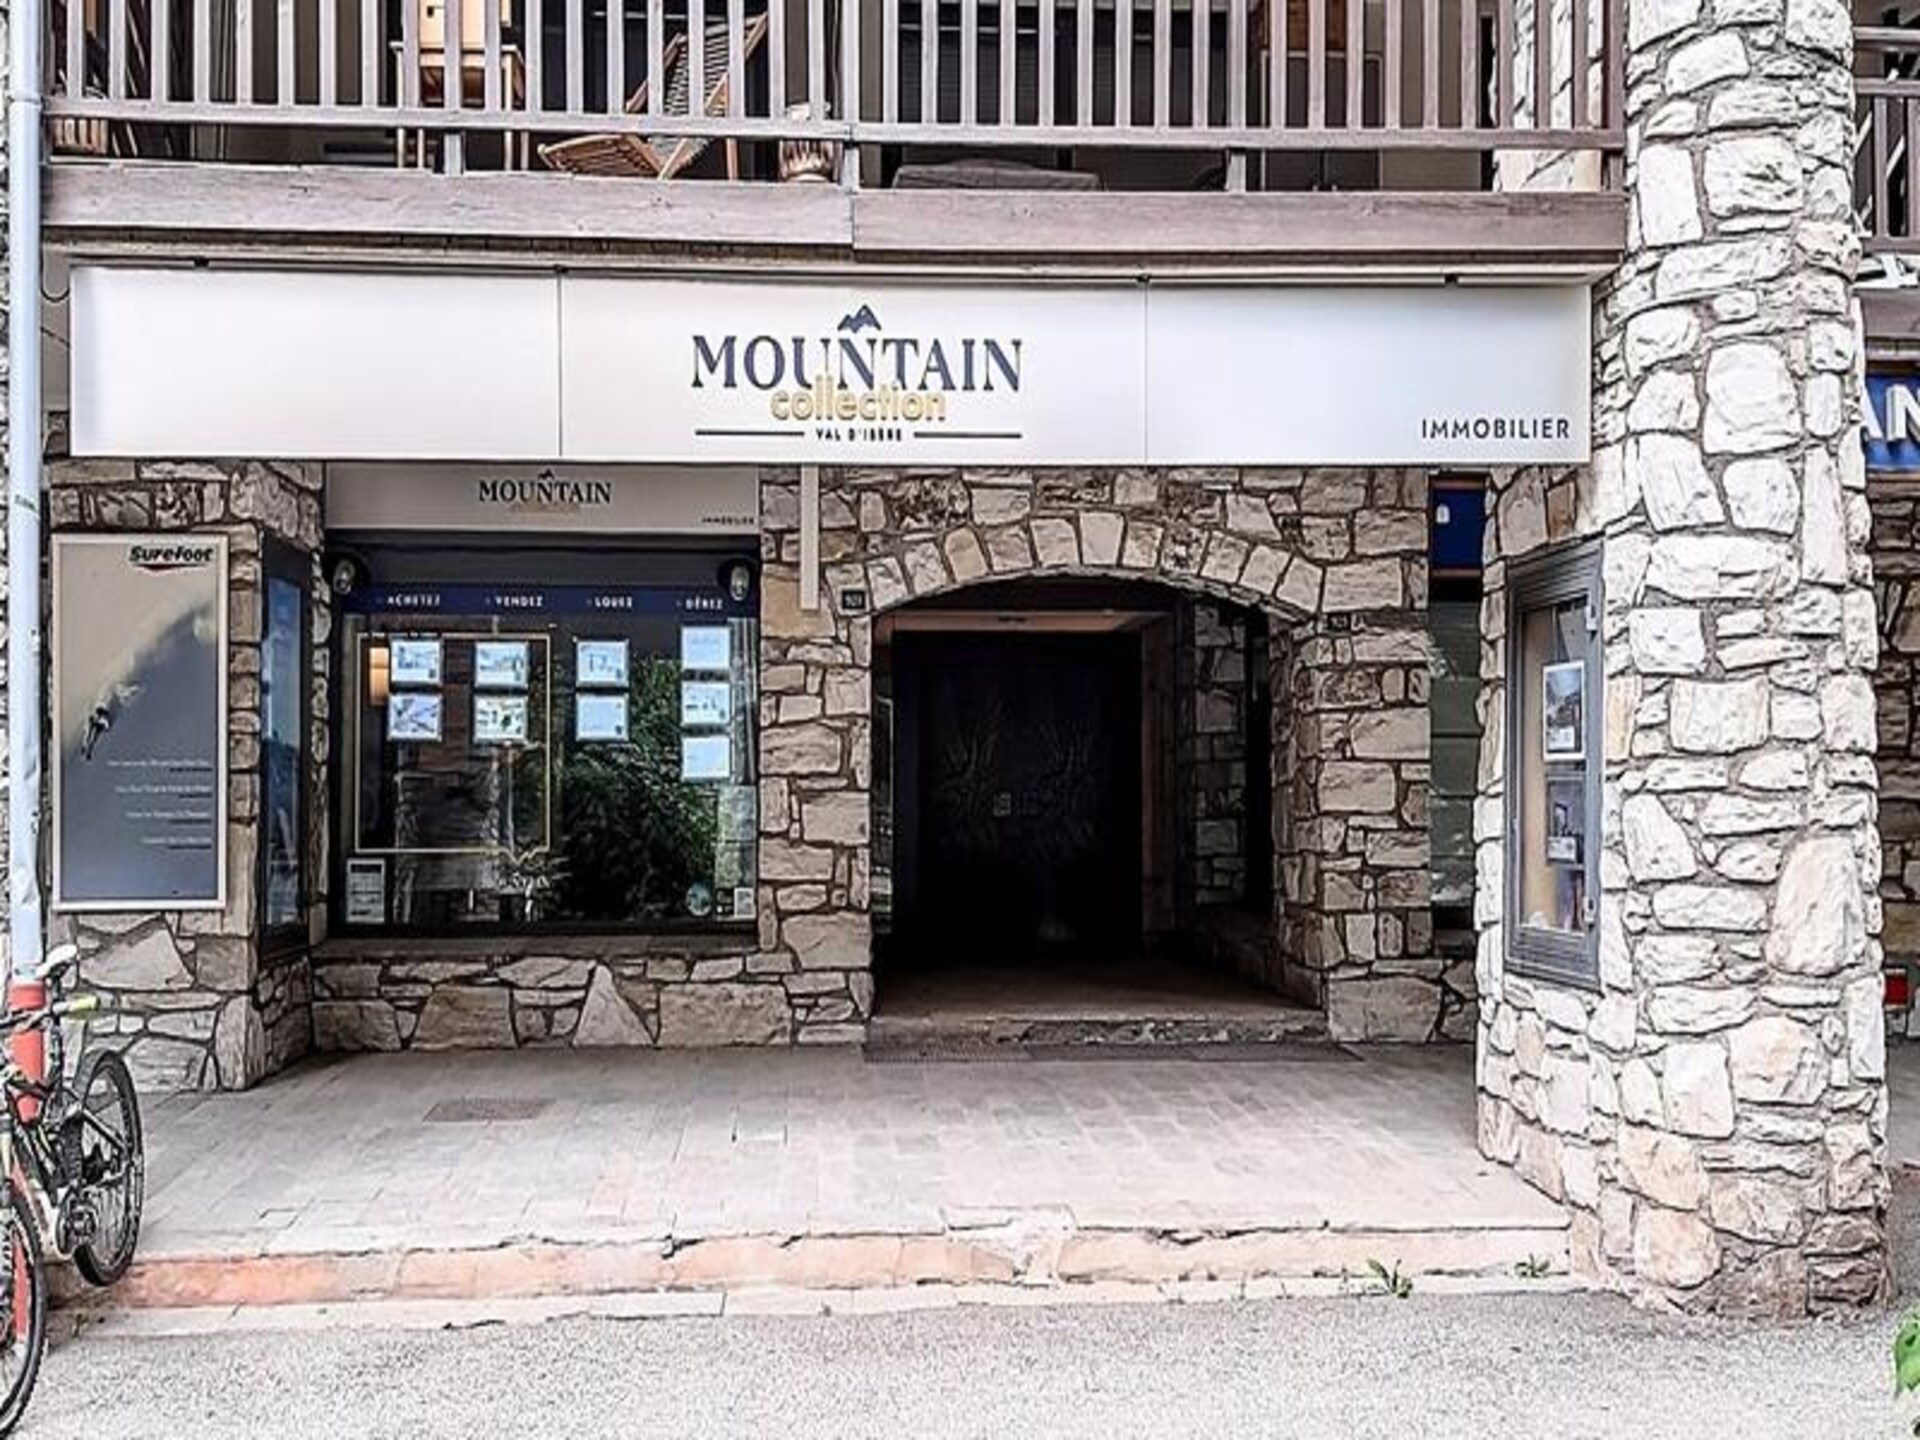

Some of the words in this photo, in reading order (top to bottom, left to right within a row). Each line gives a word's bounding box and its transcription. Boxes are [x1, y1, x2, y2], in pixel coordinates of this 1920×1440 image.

[691, 335, 1023, 392] MOUNTAIN
[770, 374, 947, 422] collection
[816, 427, 841, 441] VAL
[1422, 417, 1570, 440] IMMOBILIER
[479, 480, 612, 503] MOUNTAIN
[495, 595, 544, 608] VENDEZ
[594, 596, 633, 609] LOUEZ
